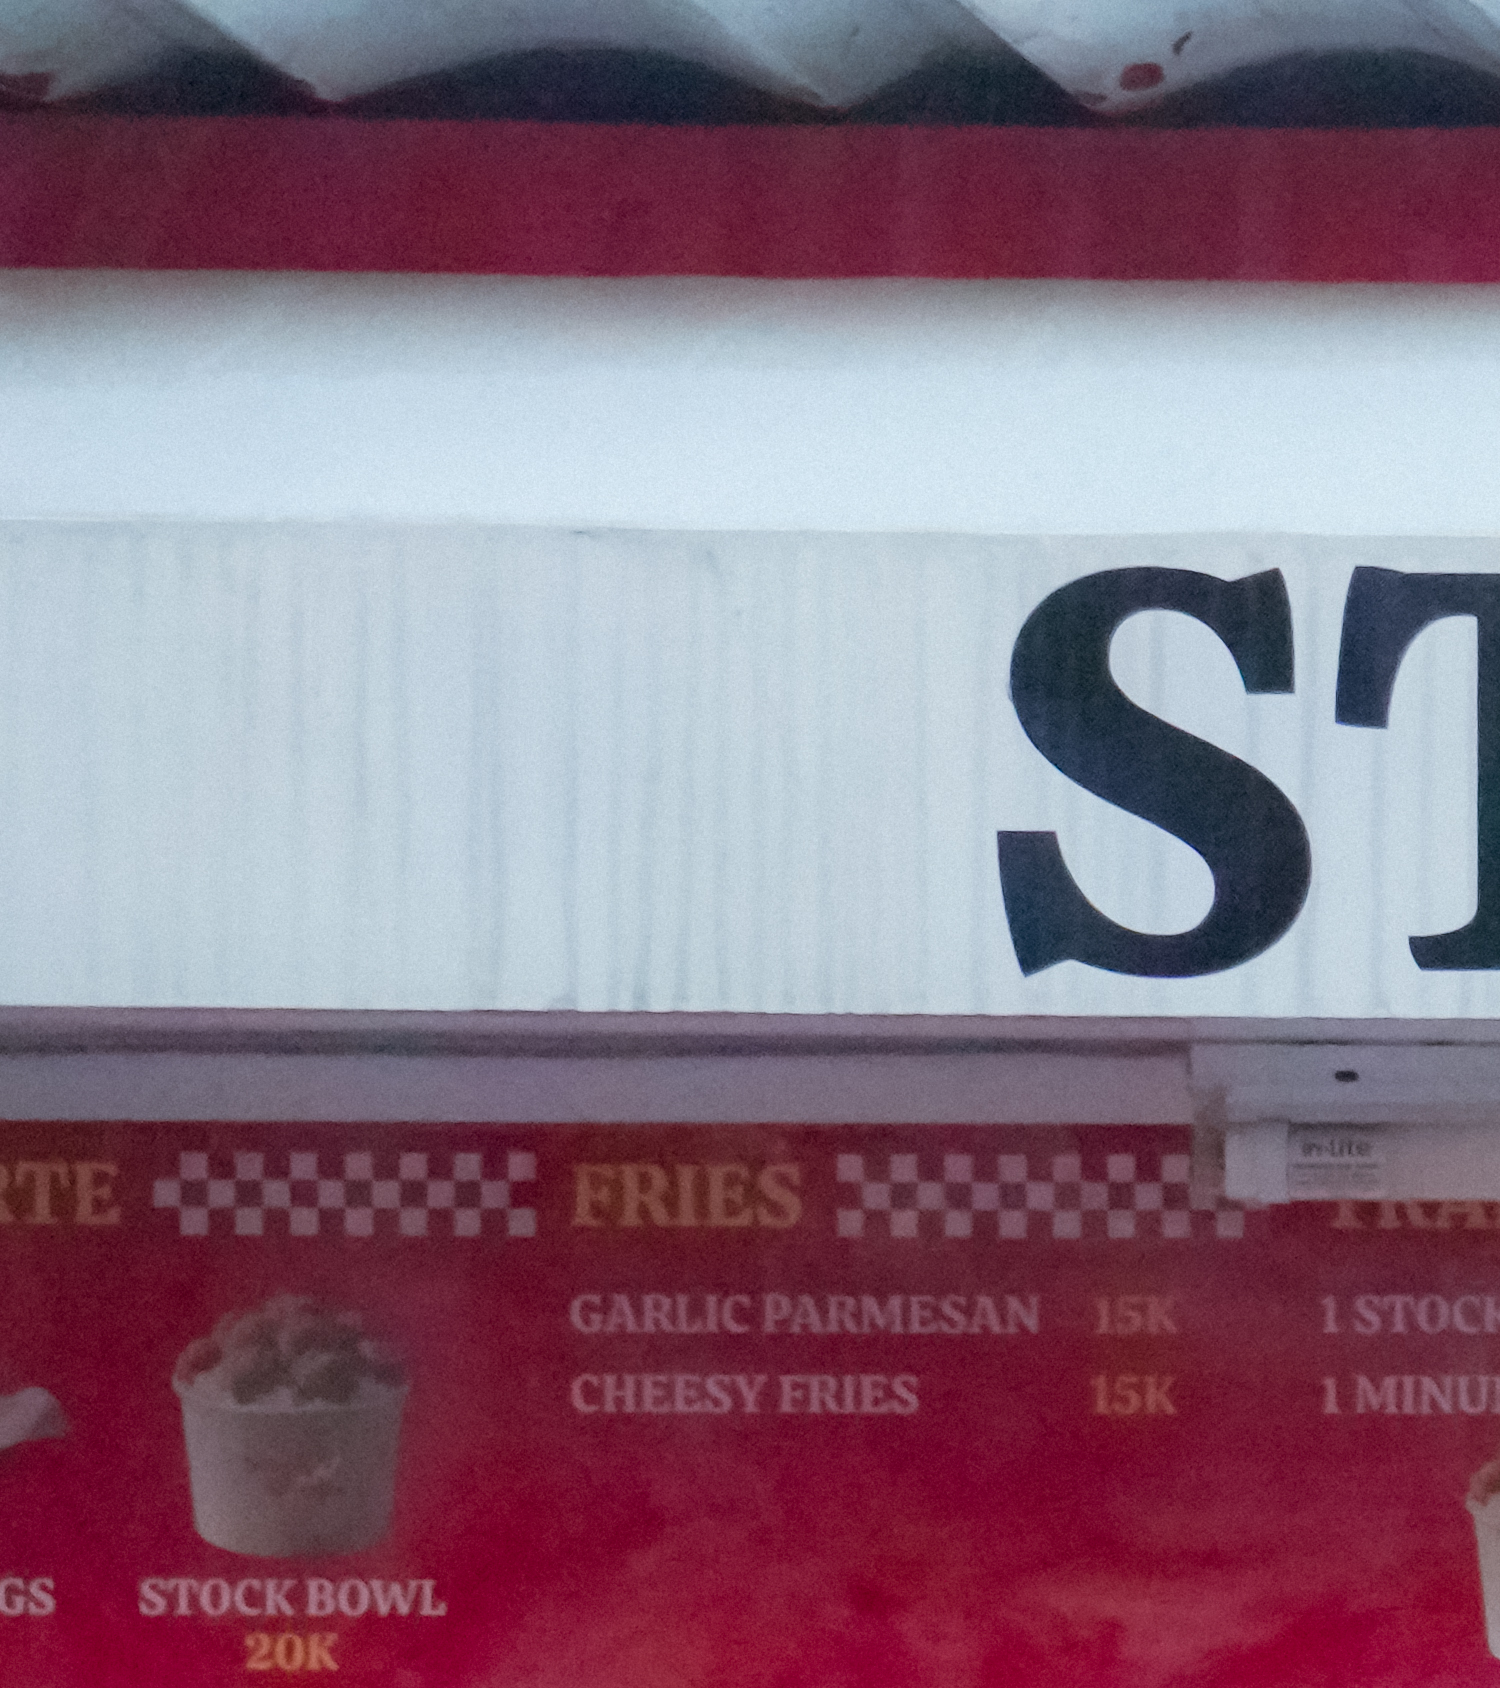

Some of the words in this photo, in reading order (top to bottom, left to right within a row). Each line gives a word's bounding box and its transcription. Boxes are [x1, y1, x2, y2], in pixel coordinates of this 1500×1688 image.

[0, 1161, 121, 1229] TE
[571, 1161, 803, 1229] FRIES
[570, 1296, 752, 1335] GARLIC
[763, 1296, 1040, 1335] PARMESAN
[1094, 1298, 1178, 1334] 15K
[1322, 1297, 1339, 1332] 1
[570, 1374, 767, 1415] CHEESY
[777, 1374, 920, 1415] FRIES
[1091, 1377, 1178, 1417] 15K
[1322, 1377, 1339, 1414] 1
[139, 1579, 297, 1617] STOCK
[307, 1579, 447, 1617] BOWL
[245, 1633, 339, 1671] 20K
